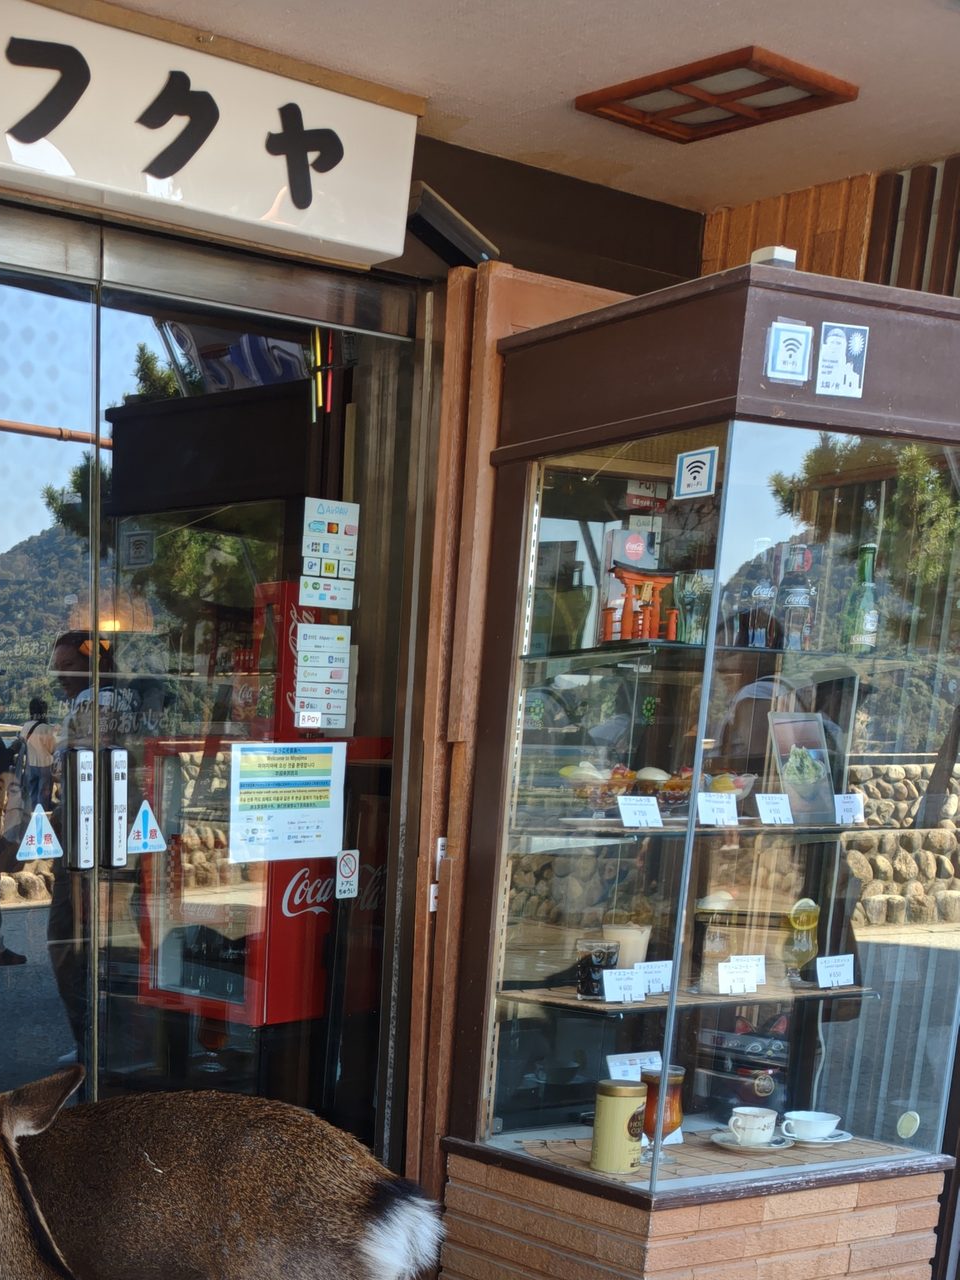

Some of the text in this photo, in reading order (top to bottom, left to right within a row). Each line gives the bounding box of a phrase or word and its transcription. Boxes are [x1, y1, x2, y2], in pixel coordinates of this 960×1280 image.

[5, 36, 344, 210] フクヤ
[686, 481, 703, 489] Wi-Fi
[80, 760, 93, 770] AUTO
[114, 759, 127, 770] AUTO
[80, 772, 93, 782] 自動
[114, 772, 127, 781] 自動
[81, 805, 93, 815] PUSH
[114, 804, 127, 814] PUSH
